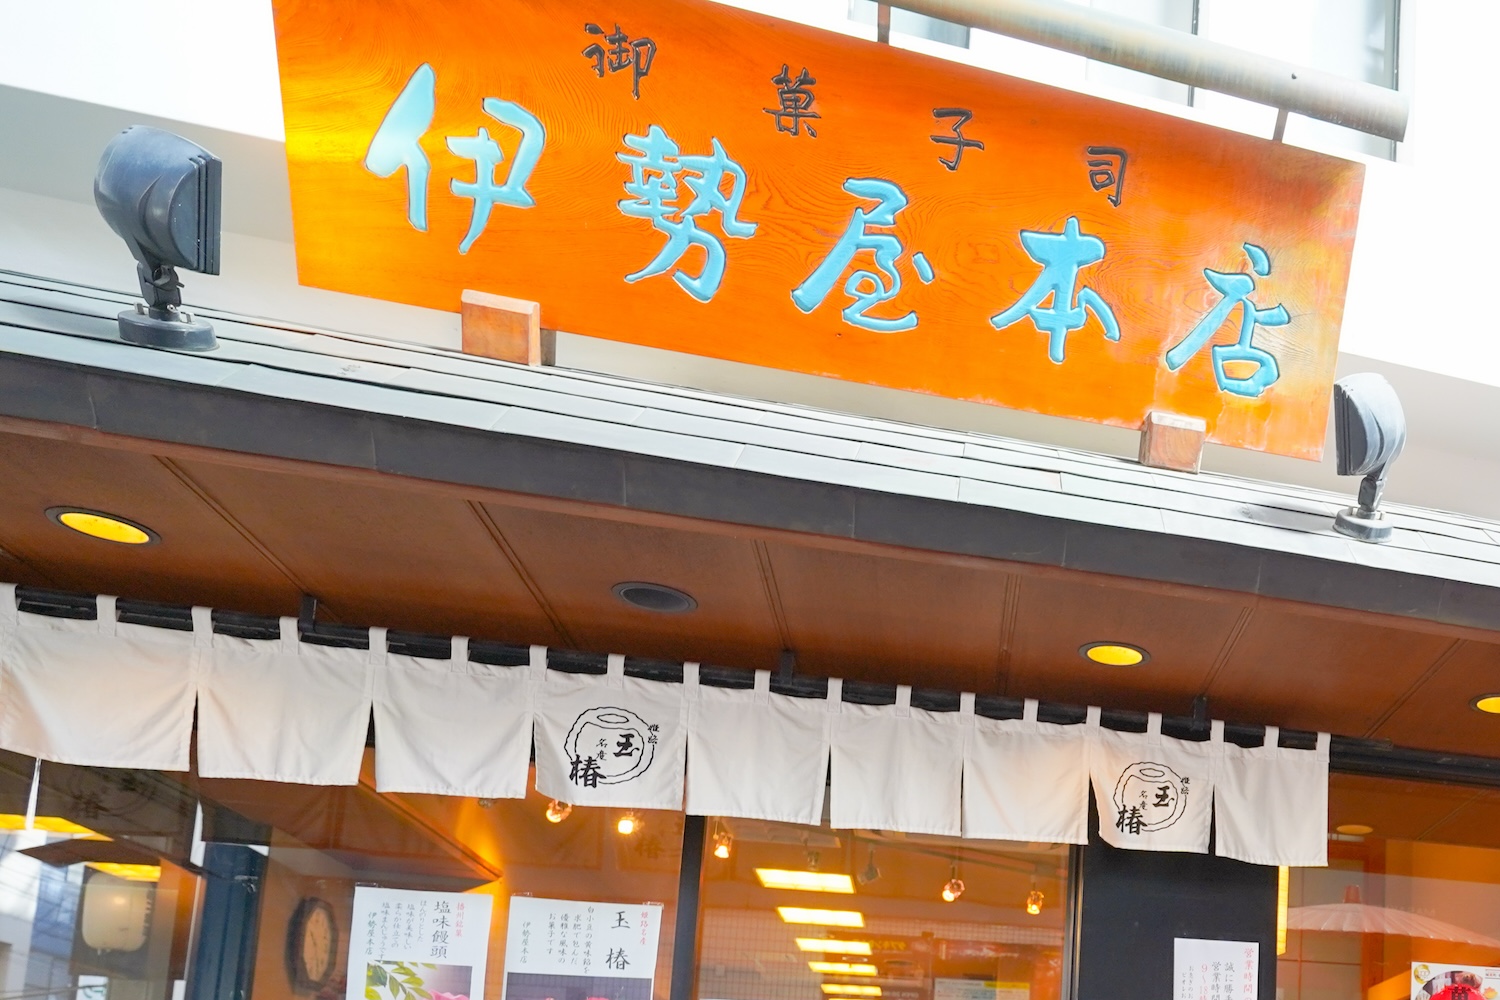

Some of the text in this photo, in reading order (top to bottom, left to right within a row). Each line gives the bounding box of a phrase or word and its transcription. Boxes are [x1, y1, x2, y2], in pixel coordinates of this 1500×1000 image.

[583, 23, 1131, 207] 御菓子司
[363, 62, 1293, 398] 伊勢屋本店
[365, 911, 377, 955] 伊勢屋本店
[430, 900, 452, 959] 塩味饅頭
[520, 921, 531, 964] 伊勢屋本店
[605, 910, 631, 970] 玉椿
